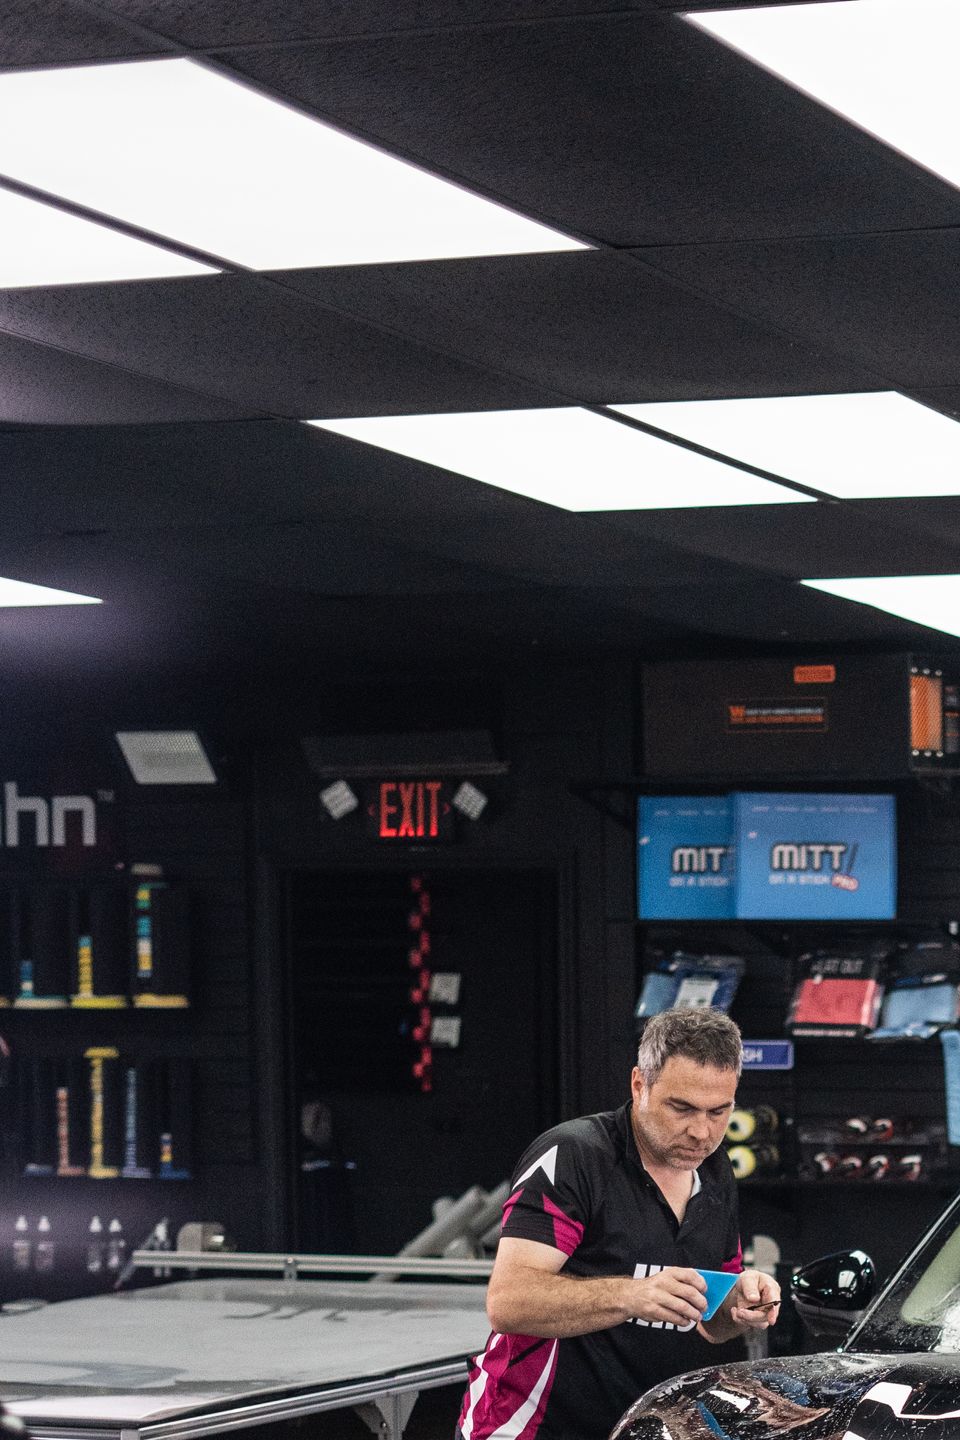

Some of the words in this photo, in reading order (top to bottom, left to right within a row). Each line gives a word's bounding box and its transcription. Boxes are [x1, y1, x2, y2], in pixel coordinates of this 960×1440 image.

[0, 782, 97, 847] hn
[380, 782, 441, 837] EXIT
[771, 843, 847, 871] MITT
